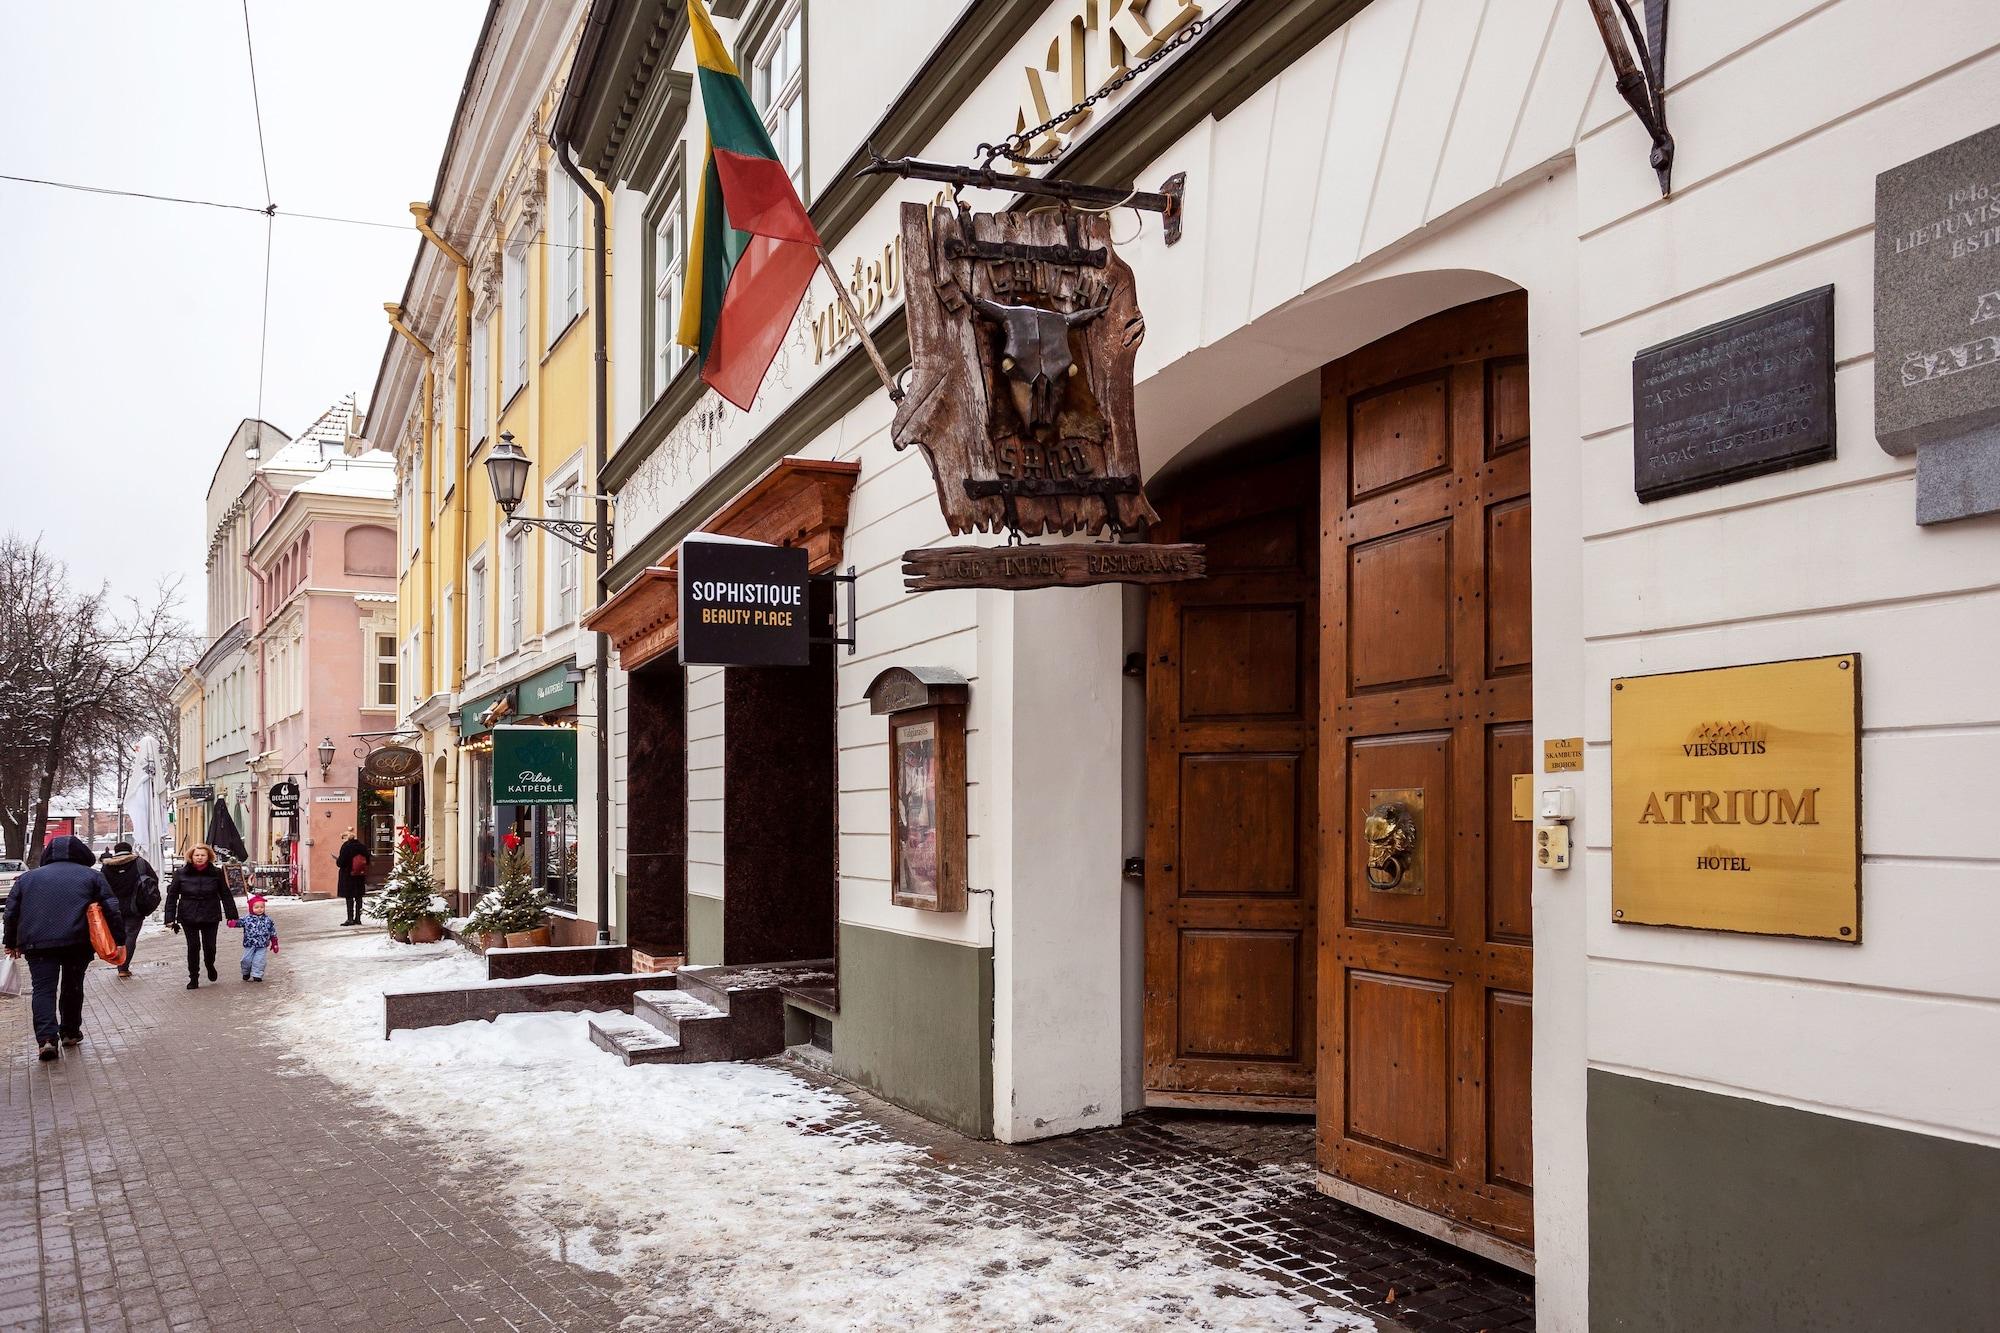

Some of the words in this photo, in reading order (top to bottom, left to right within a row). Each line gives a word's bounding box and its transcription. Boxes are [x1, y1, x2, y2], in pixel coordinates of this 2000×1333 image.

[1012, 0, 1202, 177] ATR
[692, 581, 801, 606] SOPHISTIQUE
[702, 607, 751, 625] BEAUTY
[754, 610, 793, 627] PLACE
[1555, 741, 1572, 749] CALL
[1682, 739, 1767, 757] VIEŠBUTIS
[1545, 751, 1582, 759] SKAMBUTIS
[518, 770, 552, 784] Pilies
[508, 784, 564, 793] KATPĖDĖLĖ
[1638, 787, 1820, 826] ATRIUM
[1696, 856, 1751, 871] HOTEL
